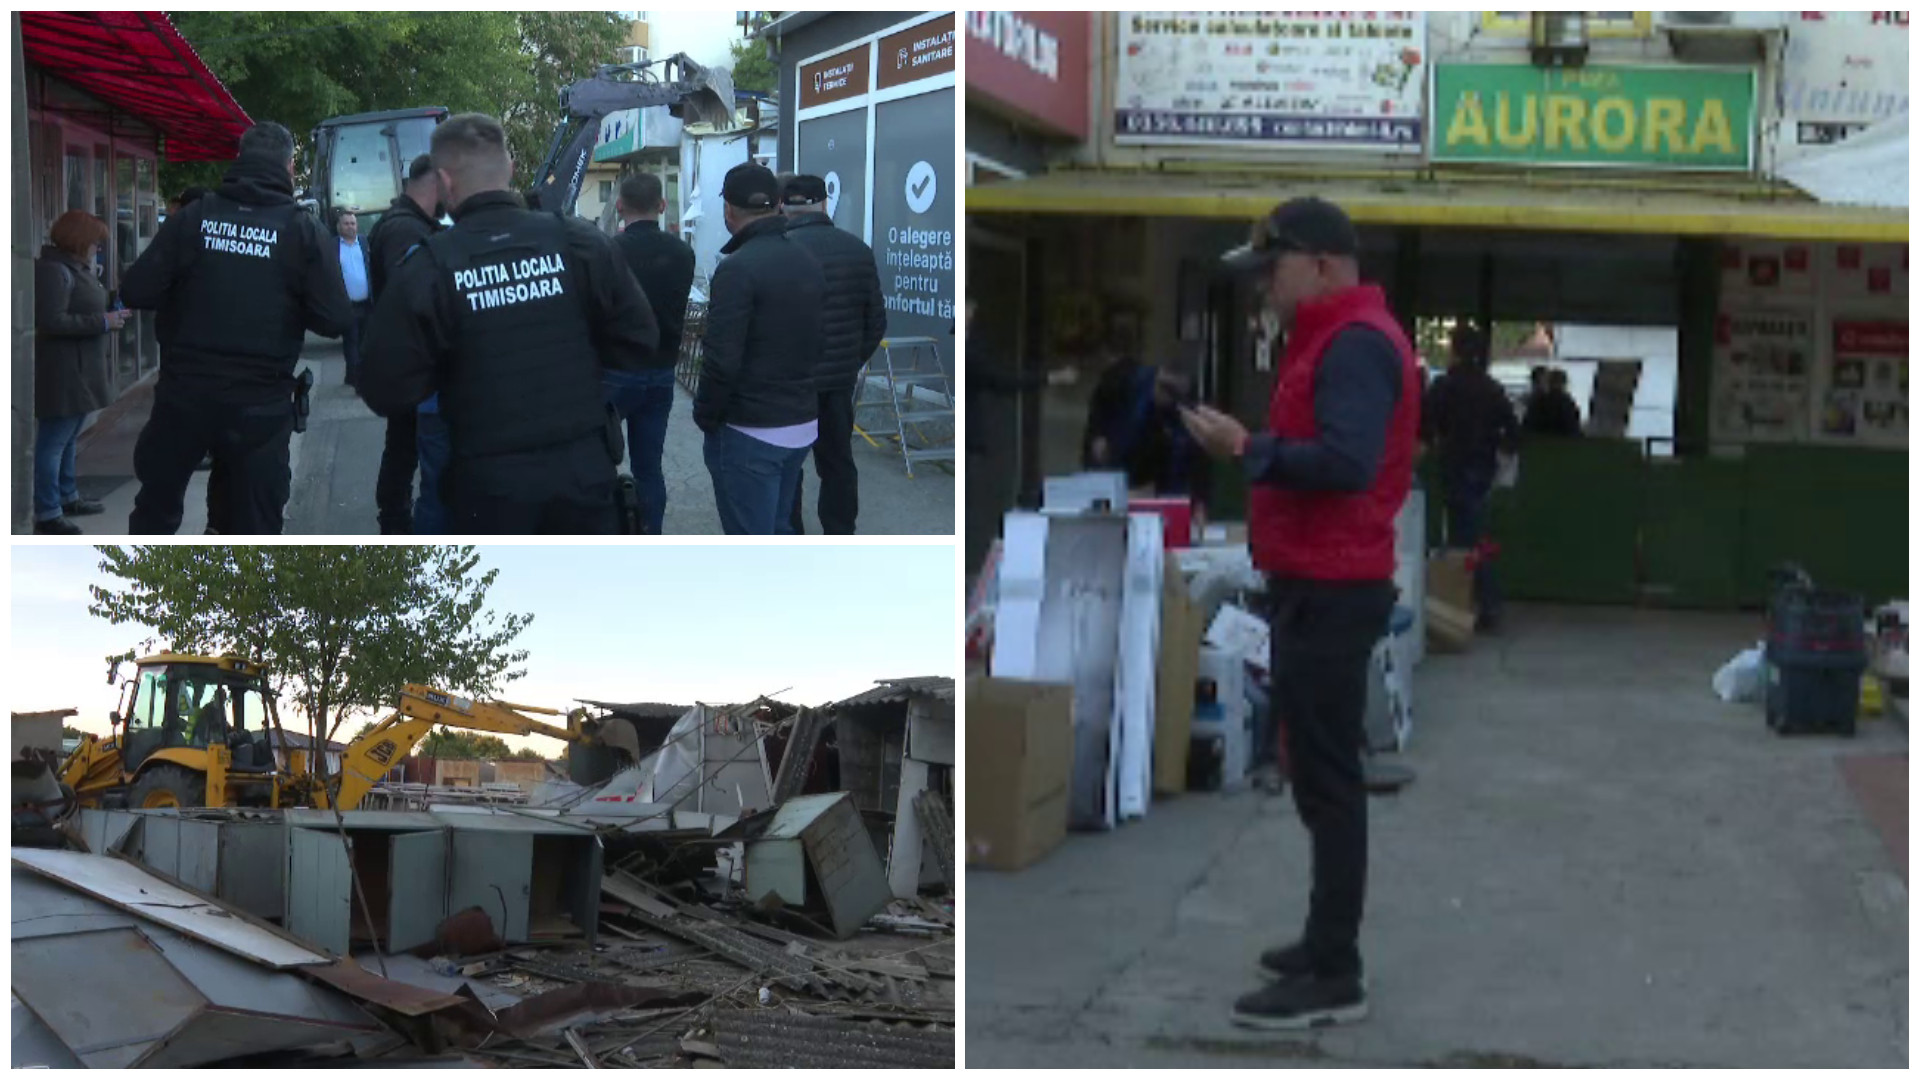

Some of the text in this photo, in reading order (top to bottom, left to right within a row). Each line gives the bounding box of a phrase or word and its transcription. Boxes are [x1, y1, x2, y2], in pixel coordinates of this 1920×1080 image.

[912, 45, 953, 67] SANITARE
[1446, 90, 1738, 154] AURORA
[200, 219, 278, 244] POLITIA LOCALA
[888, 226, 952, 249] O alegere
[204, 236, 270, 258] TIMISOARA
[454, 253, 565, 291] POLITIA LOCALA
[895, 274, 938, 293] pentru
[466, 277, 563, 311] TIMISOARA
[883, 292, 935, 317] onfortul
